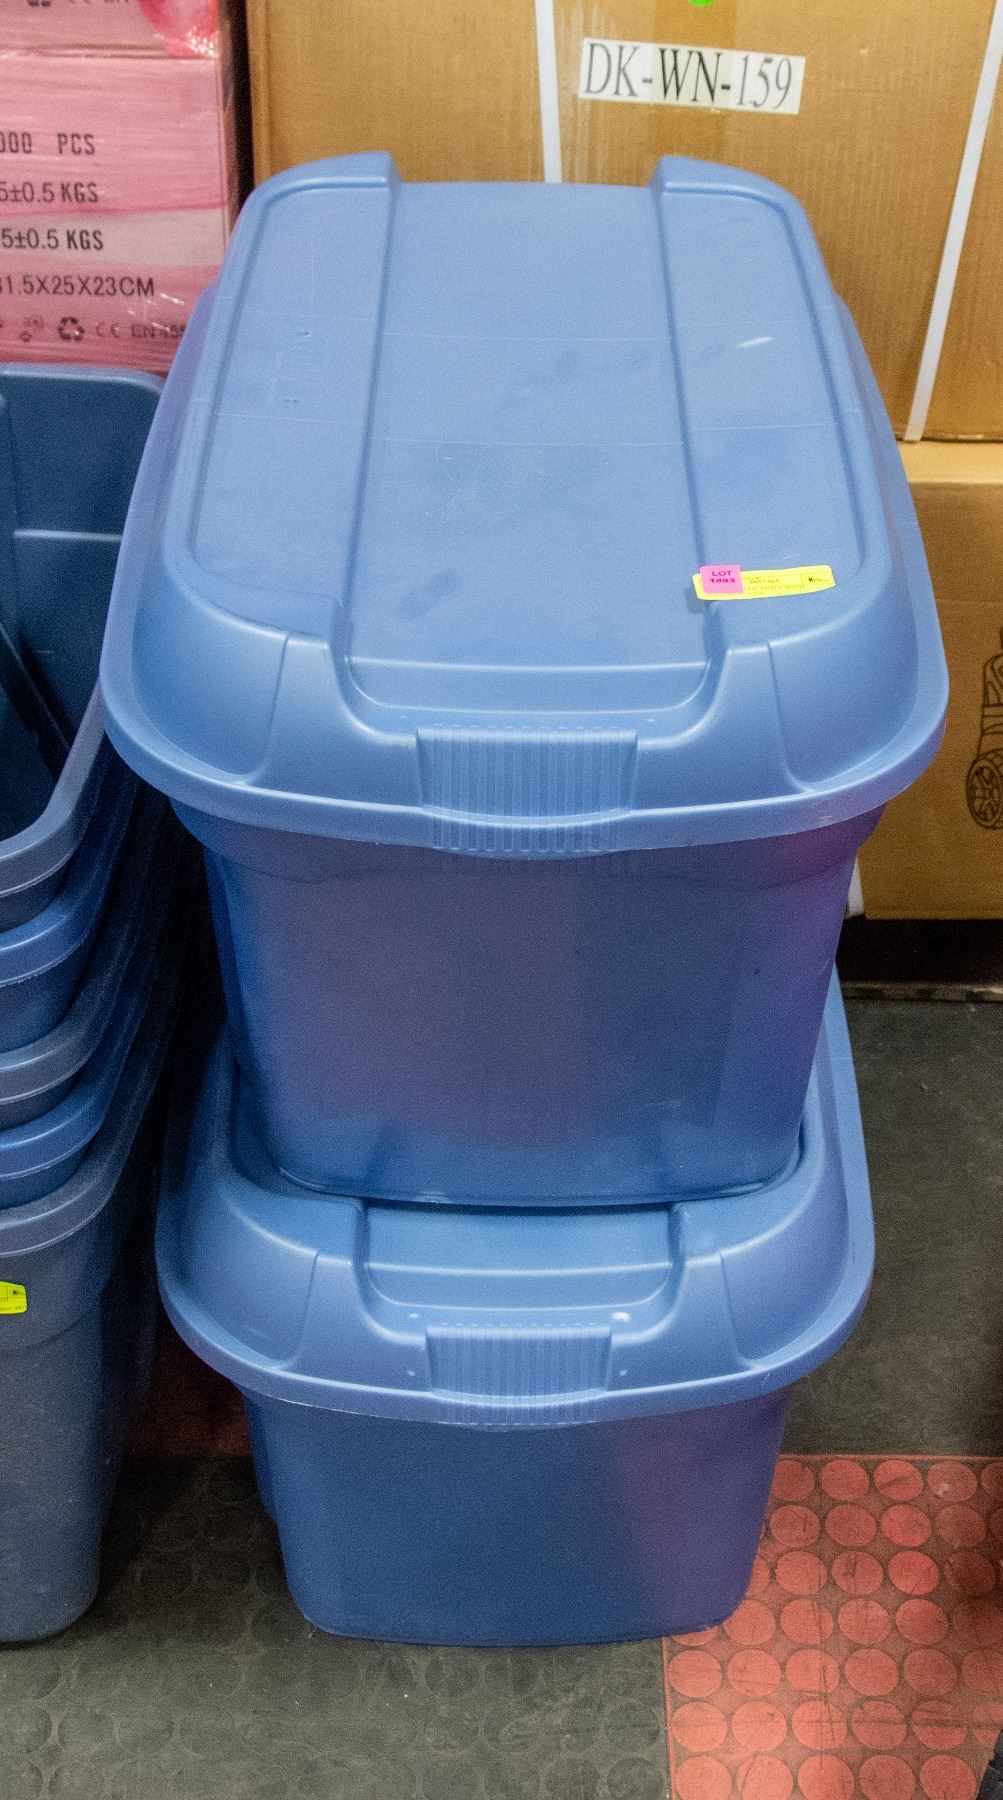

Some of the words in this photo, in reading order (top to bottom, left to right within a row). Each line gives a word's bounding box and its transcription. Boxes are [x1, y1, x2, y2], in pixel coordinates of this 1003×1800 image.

[584, 42, 792, 109] DK-WN-159
[57, 133, 95, 155] PCS
[61, 182, 98, 203] KGS
[67, 229, 104, 250] KGS
[0, 275, 155, 297] 1.5X25X23CM
